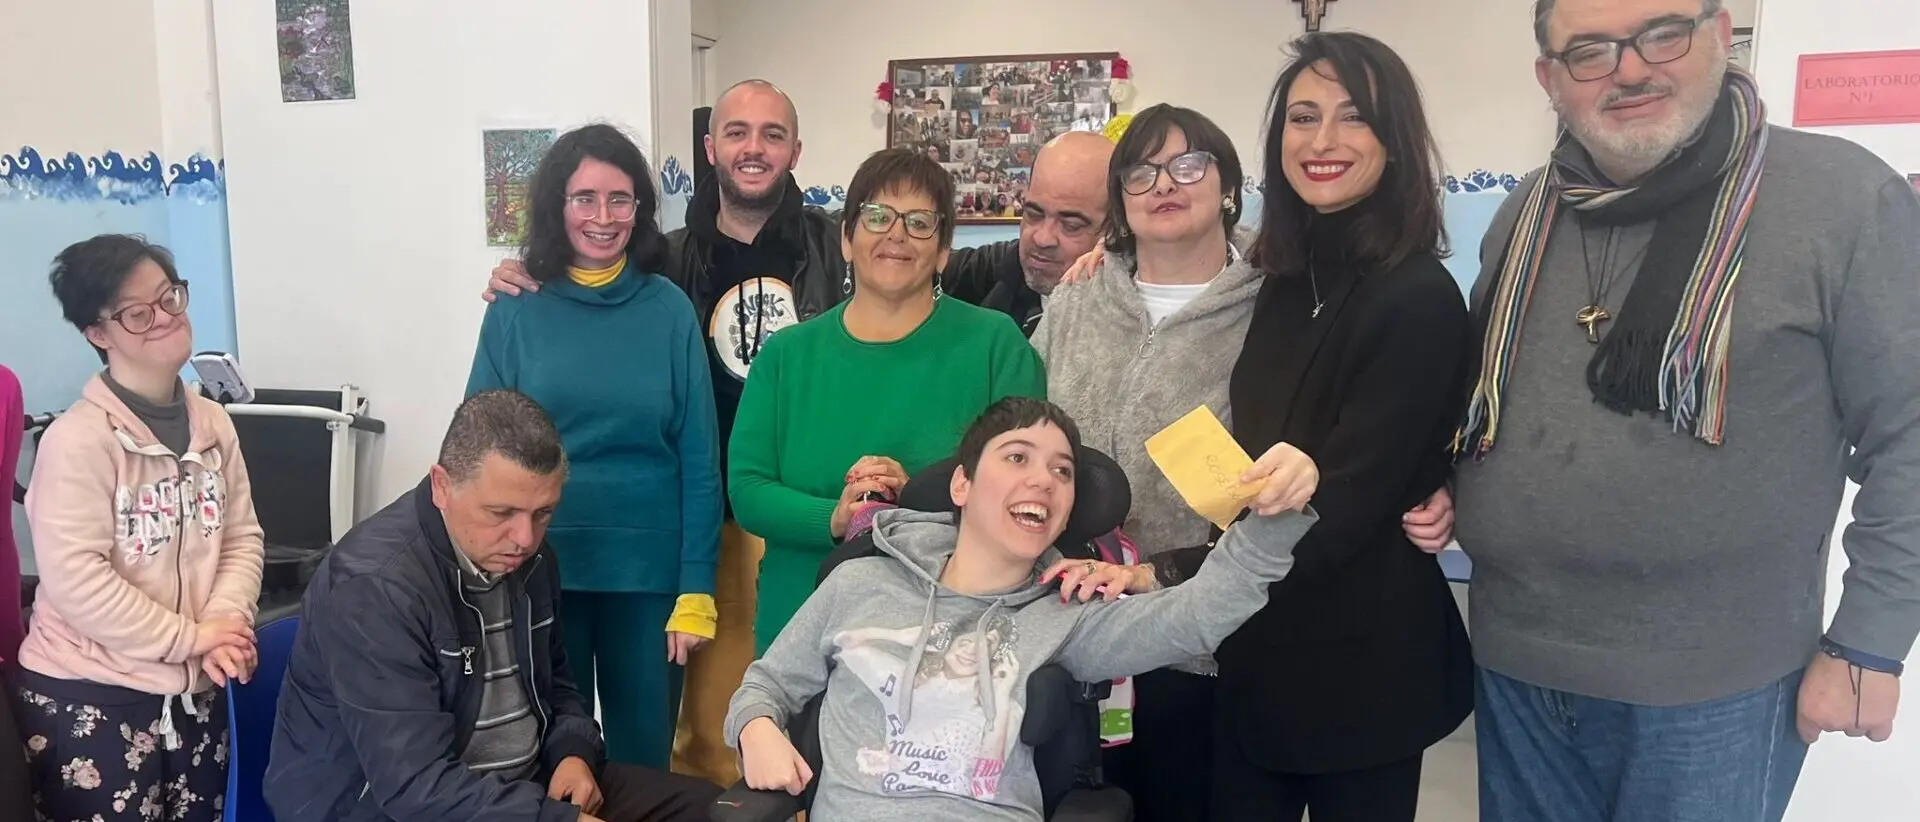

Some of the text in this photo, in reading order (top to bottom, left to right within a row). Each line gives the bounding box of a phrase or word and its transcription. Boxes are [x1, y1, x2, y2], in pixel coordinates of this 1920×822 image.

[1804, 73, 1920, 89] LABORATORIO
[889, 740, 948, 761] Music
[902, 761, 951, 784] Love
